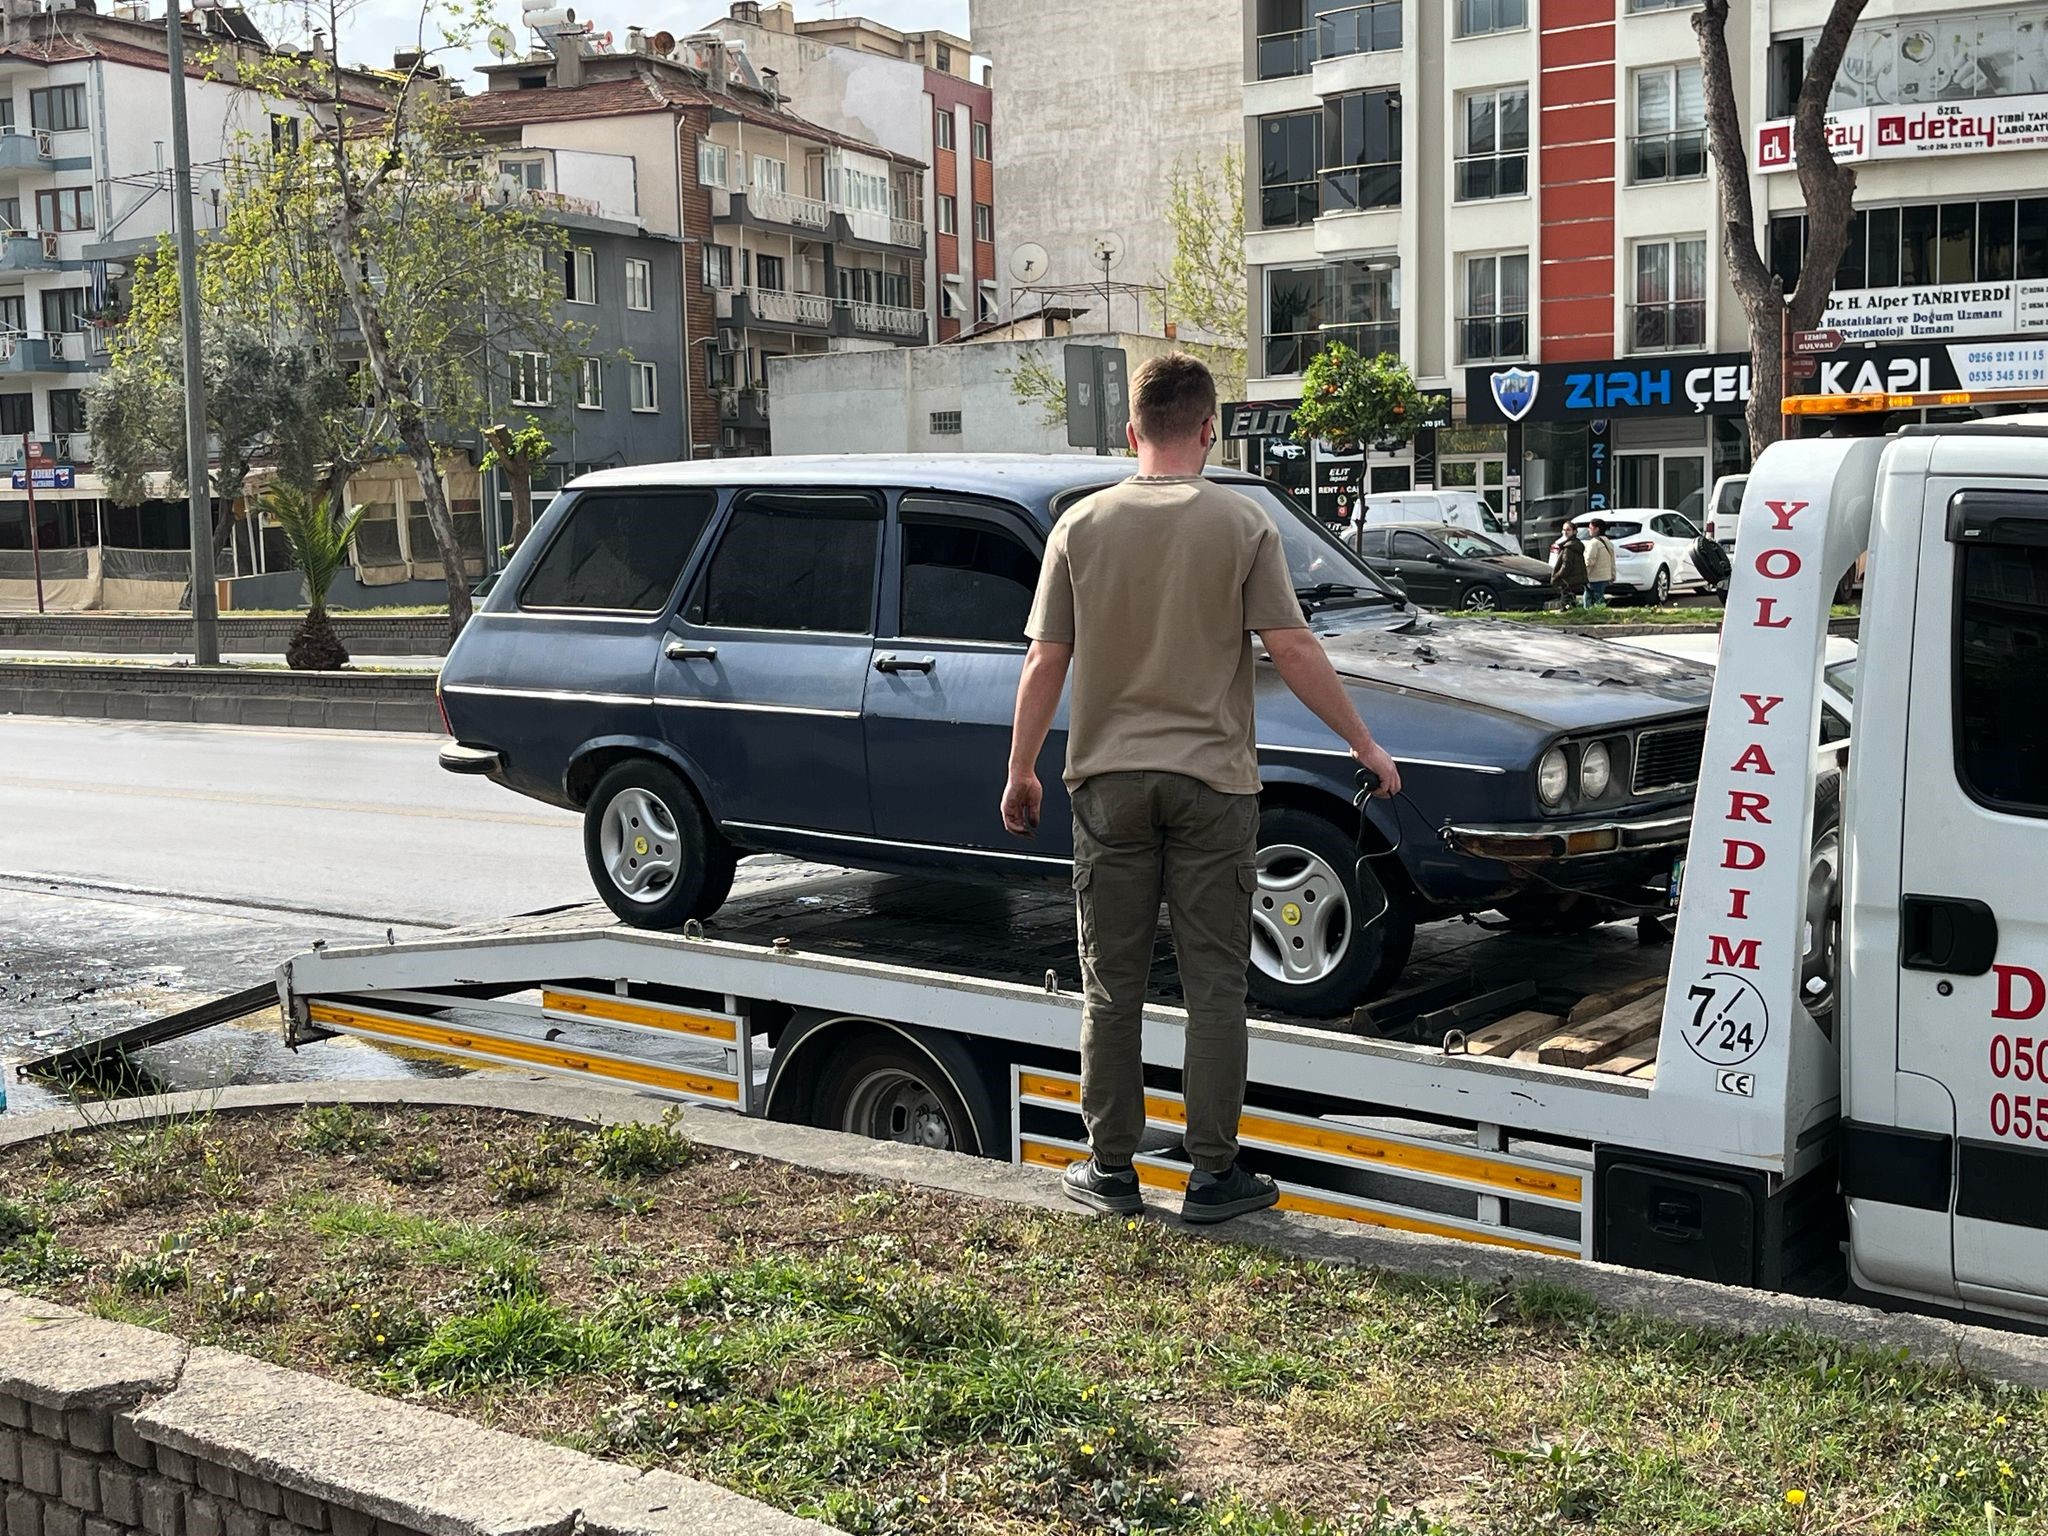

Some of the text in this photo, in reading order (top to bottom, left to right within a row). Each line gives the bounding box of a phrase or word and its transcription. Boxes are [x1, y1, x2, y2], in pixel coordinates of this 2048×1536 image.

[1937, 105, 1963, 115] ÖZEL
[1824, 116, 1839, 124] ZEL
[1908, 111, 1995, 148] detay
[1848, 296, 1862, 309] H.
[1866, 295, 1908, 310] Alper
[1912, 284, 2010, 306] TANRIVERDİ
[1827, 315, 1892, 328] Hastalıkları
[1896, 315, 1909, 323] ve
[1913, 310, 1953, 324] Doğum
[1957, 310, 2002, 320] Uzmanı
[1840, 325, 1954, 339] Perinatoloji Uzmanı
[1968, 350, 2044, 363] 0256 212 11 15
[1968, 369, 2044, 382] 0535 345 51 91
[1564, 369, 1672, 409] ZIRH
[1820, 358, 1930, 394] KAPI
[1294, 487, 1310, 495] CAR
[1318, 486, 1338, 494] RENT
[1706, 501, 1809, 970] YOL YARDIM
[1721, 1073, 1750, 1095] CE
